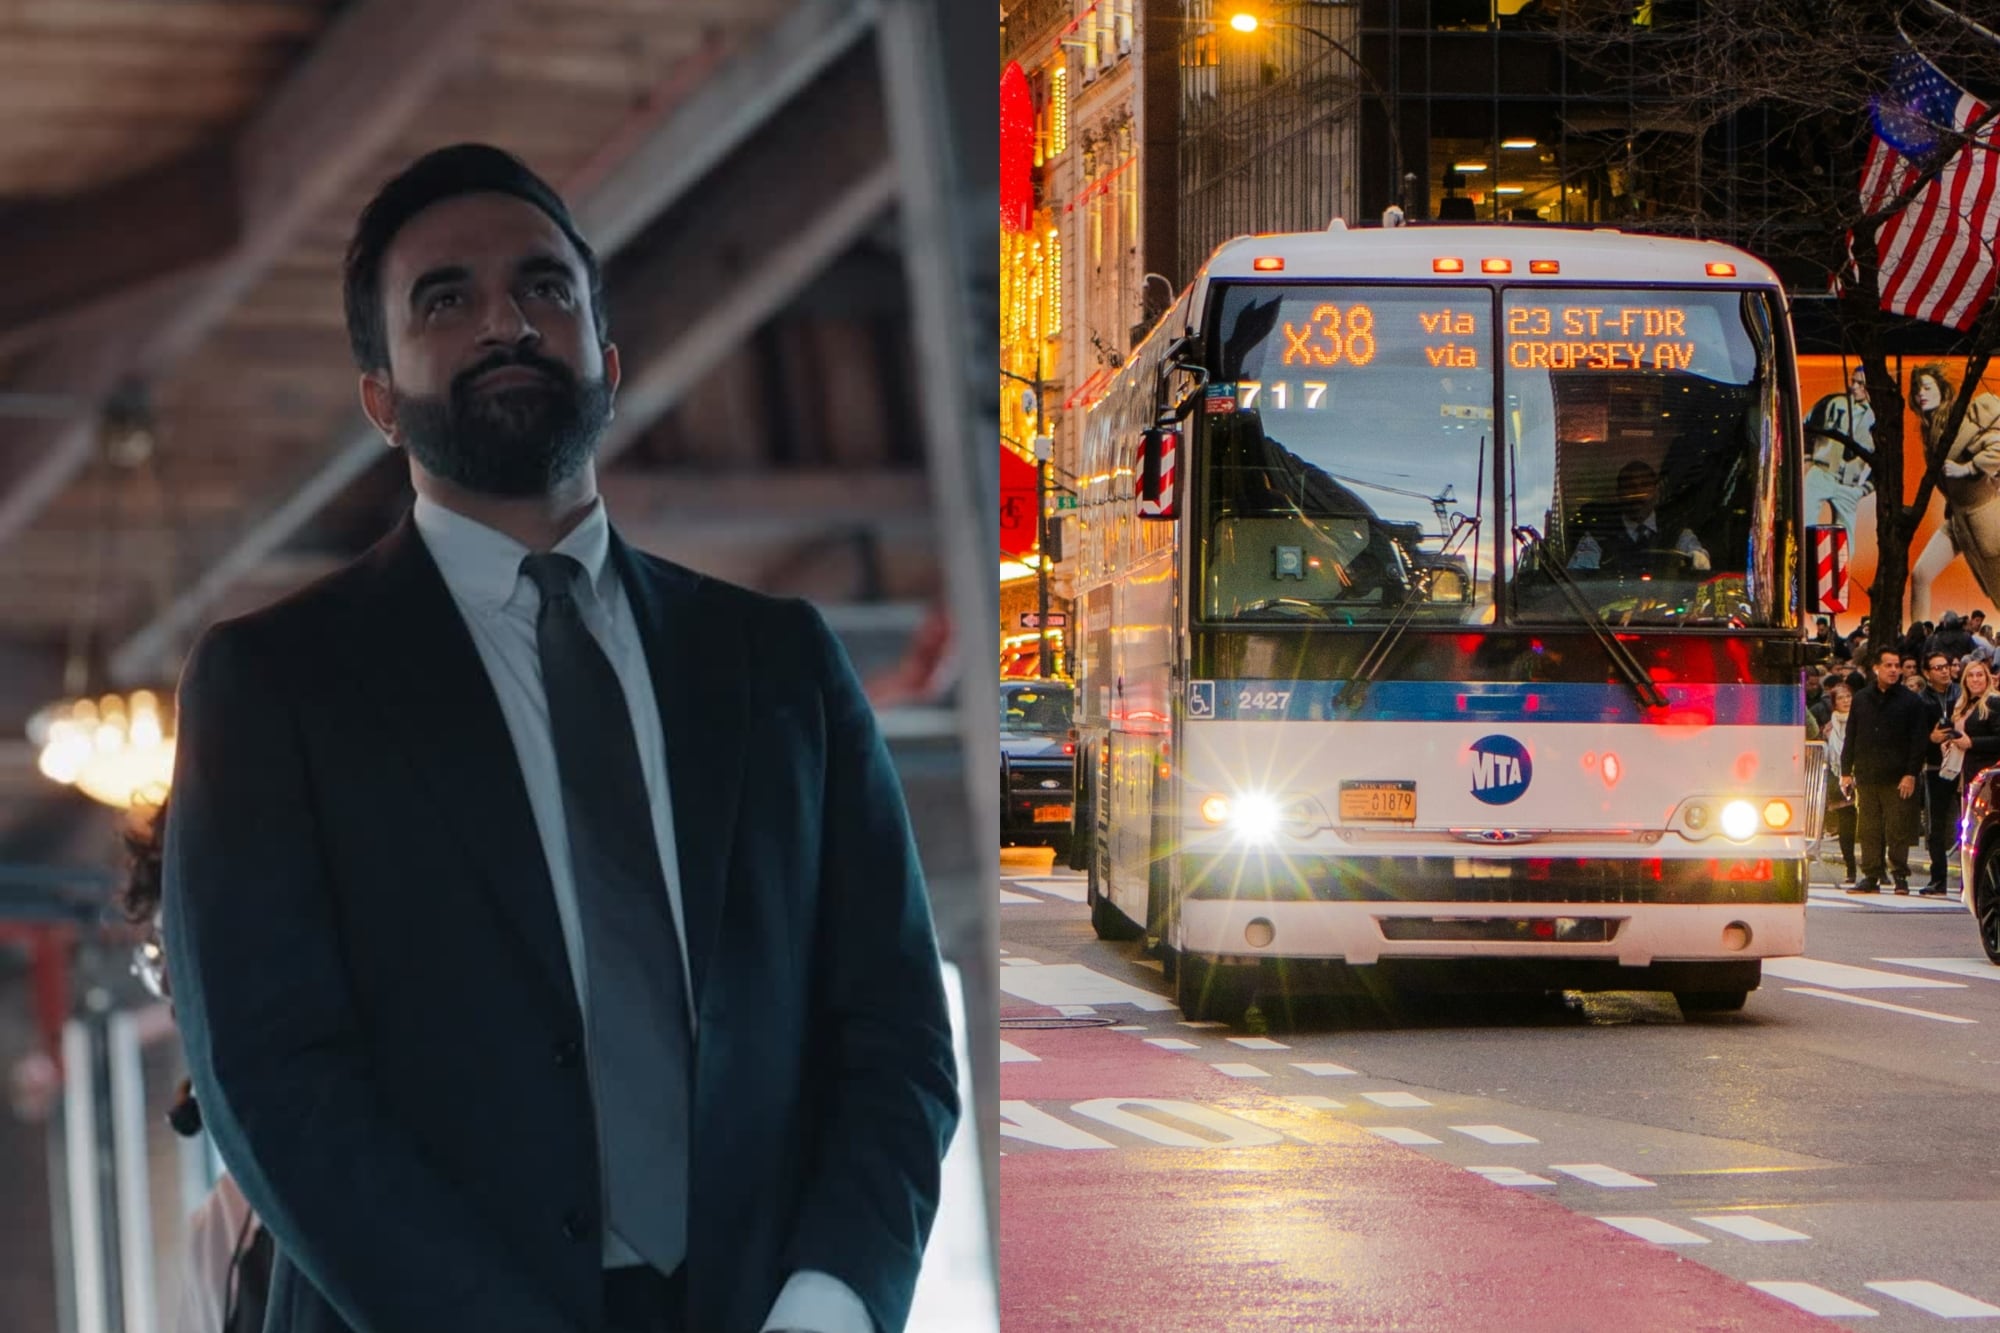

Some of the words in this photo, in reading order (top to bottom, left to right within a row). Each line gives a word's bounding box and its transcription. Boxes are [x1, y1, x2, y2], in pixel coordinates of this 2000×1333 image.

[1419, 309, 1475, 335] via
[1508, 308, 1551, 336] 23
[1563, 308, 1687, 337] ST-FDR
[1425, 343, 1477, 368] via
[1509, 342, 1645, 368] CROPSEY
[1654, 343, 1694, 369] AV
[1239, 691, 1290, 709] 2427
[1470, 750, 1522, 791] MTA
